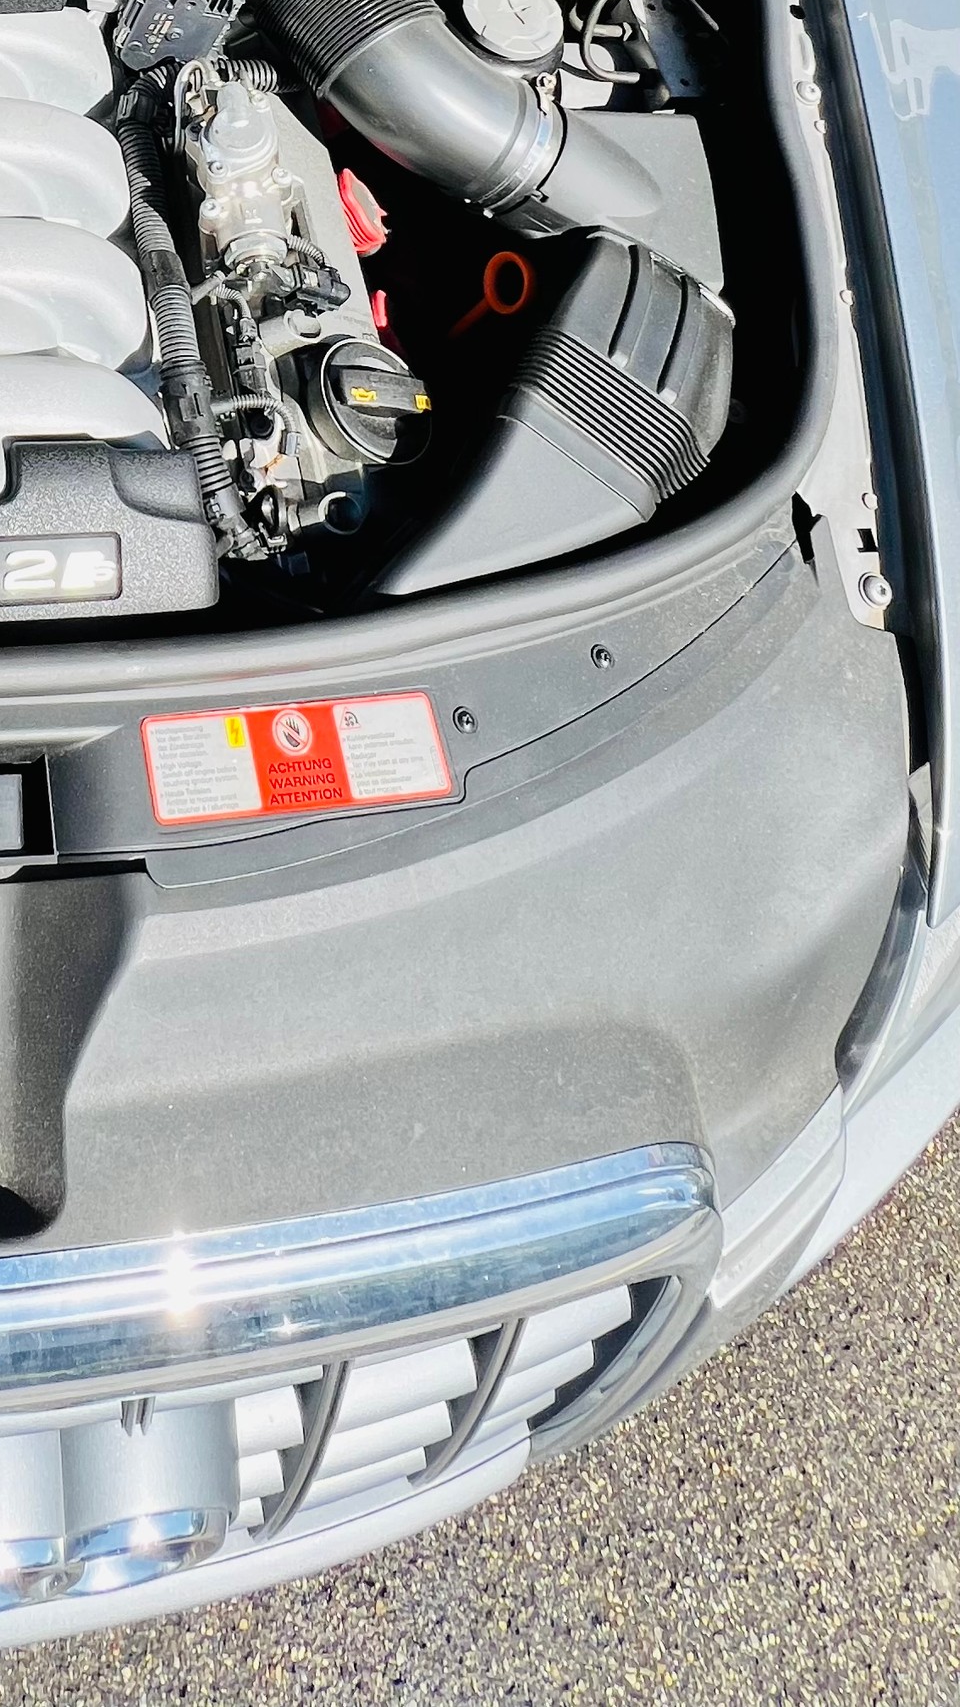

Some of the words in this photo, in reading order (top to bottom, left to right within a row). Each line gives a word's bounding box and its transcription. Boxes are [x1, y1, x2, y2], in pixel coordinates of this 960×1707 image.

[268, 758, 332, 774] ACHTUNG
[270, 772, 336, 788] WARNING
[269, 787, 343, 805] ATTENTION
